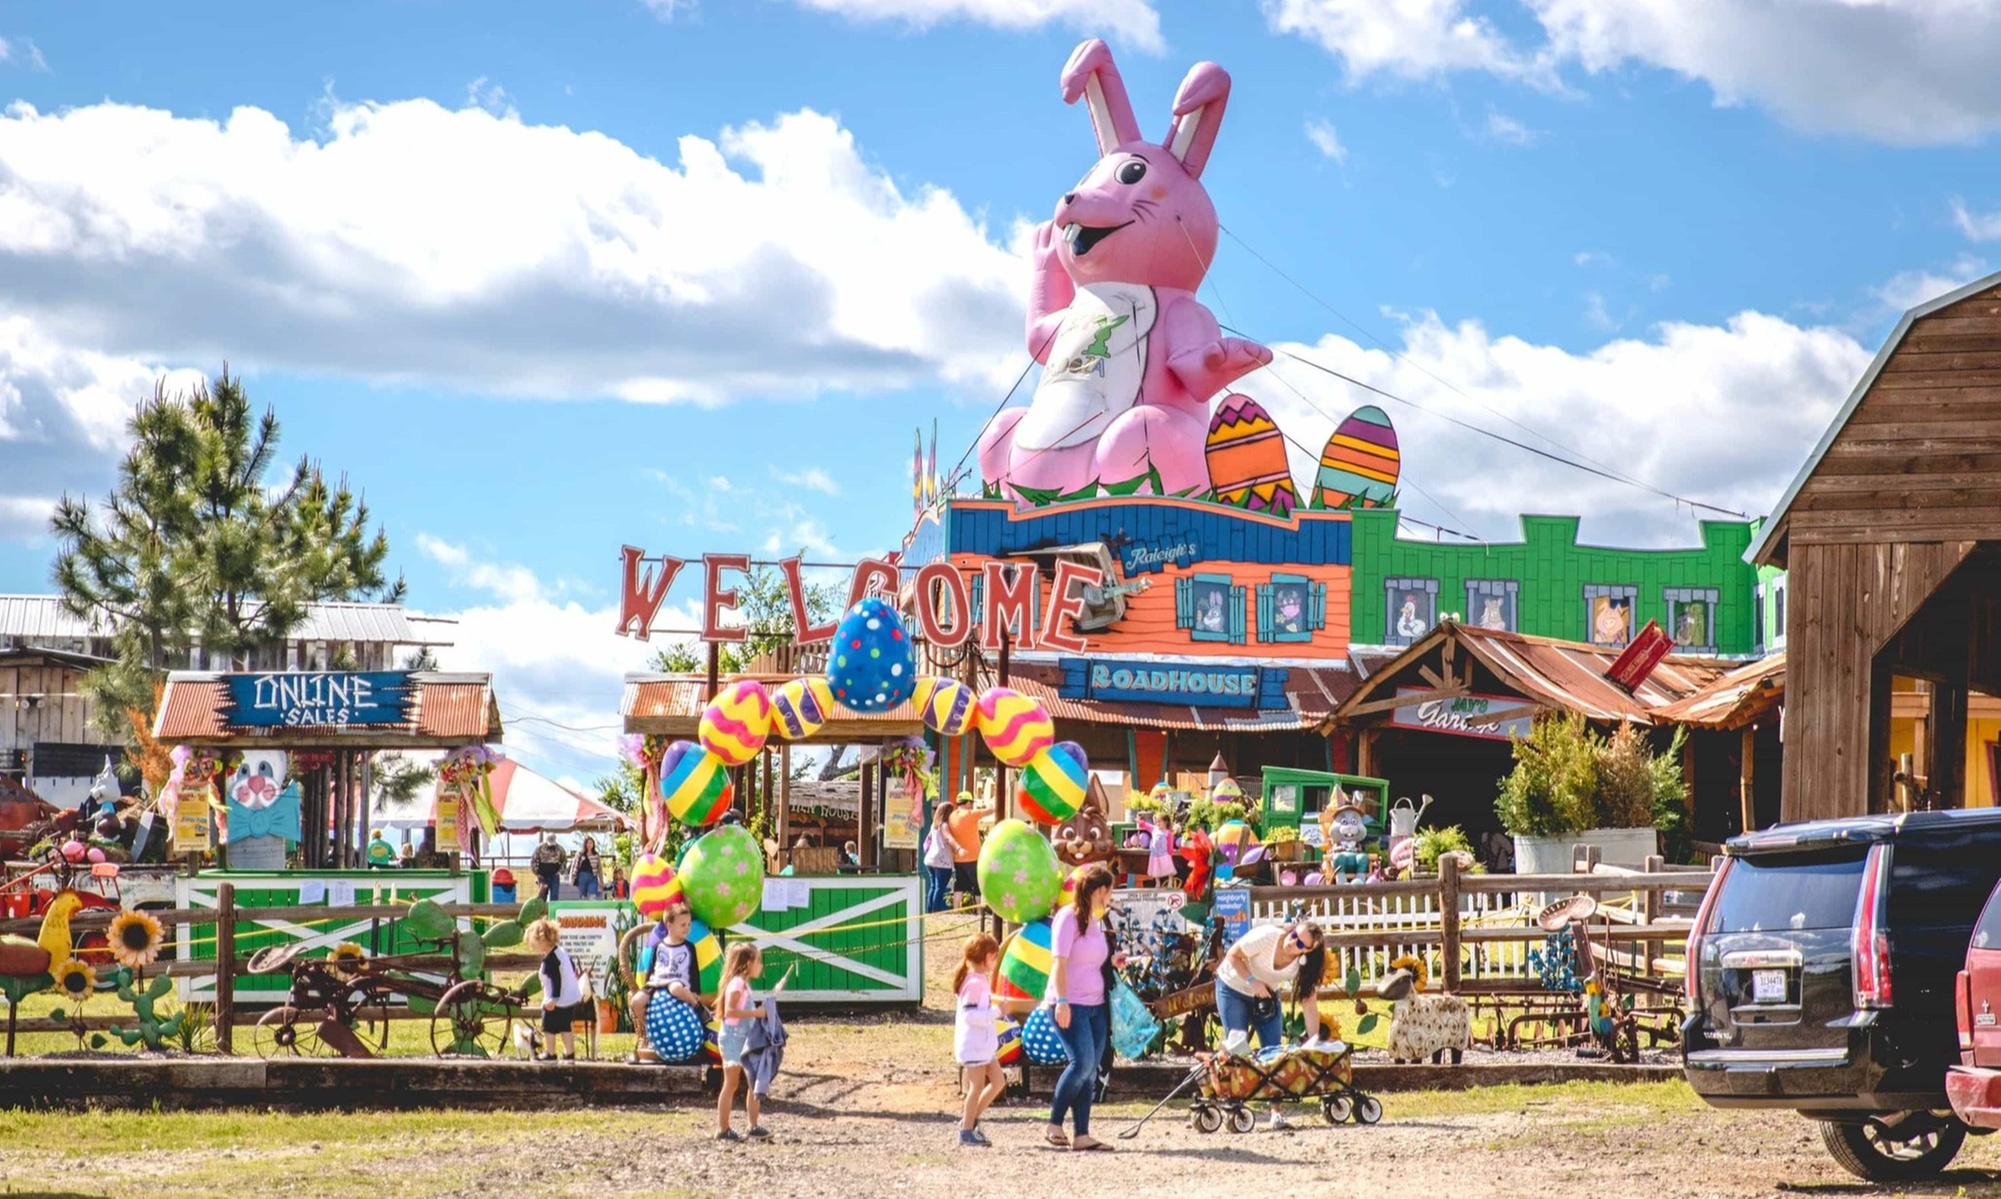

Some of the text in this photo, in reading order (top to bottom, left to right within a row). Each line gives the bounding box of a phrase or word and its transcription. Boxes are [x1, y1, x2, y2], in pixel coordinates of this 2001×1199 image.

[1125, 543, 1196, 570] Raleigh's
[615, 543, 1103, 655] WELCOME
[253, 674, 378, 710] ONLINE
[1091, 664, 1257, 696] ROADHOUSE
[285, 708, 349, 725] SALES
[1450, 696, 1489, 713] JAY'S
[820, 805, 859, 821] HOUSE
[1168, 990, 1215, 1013] Welco
